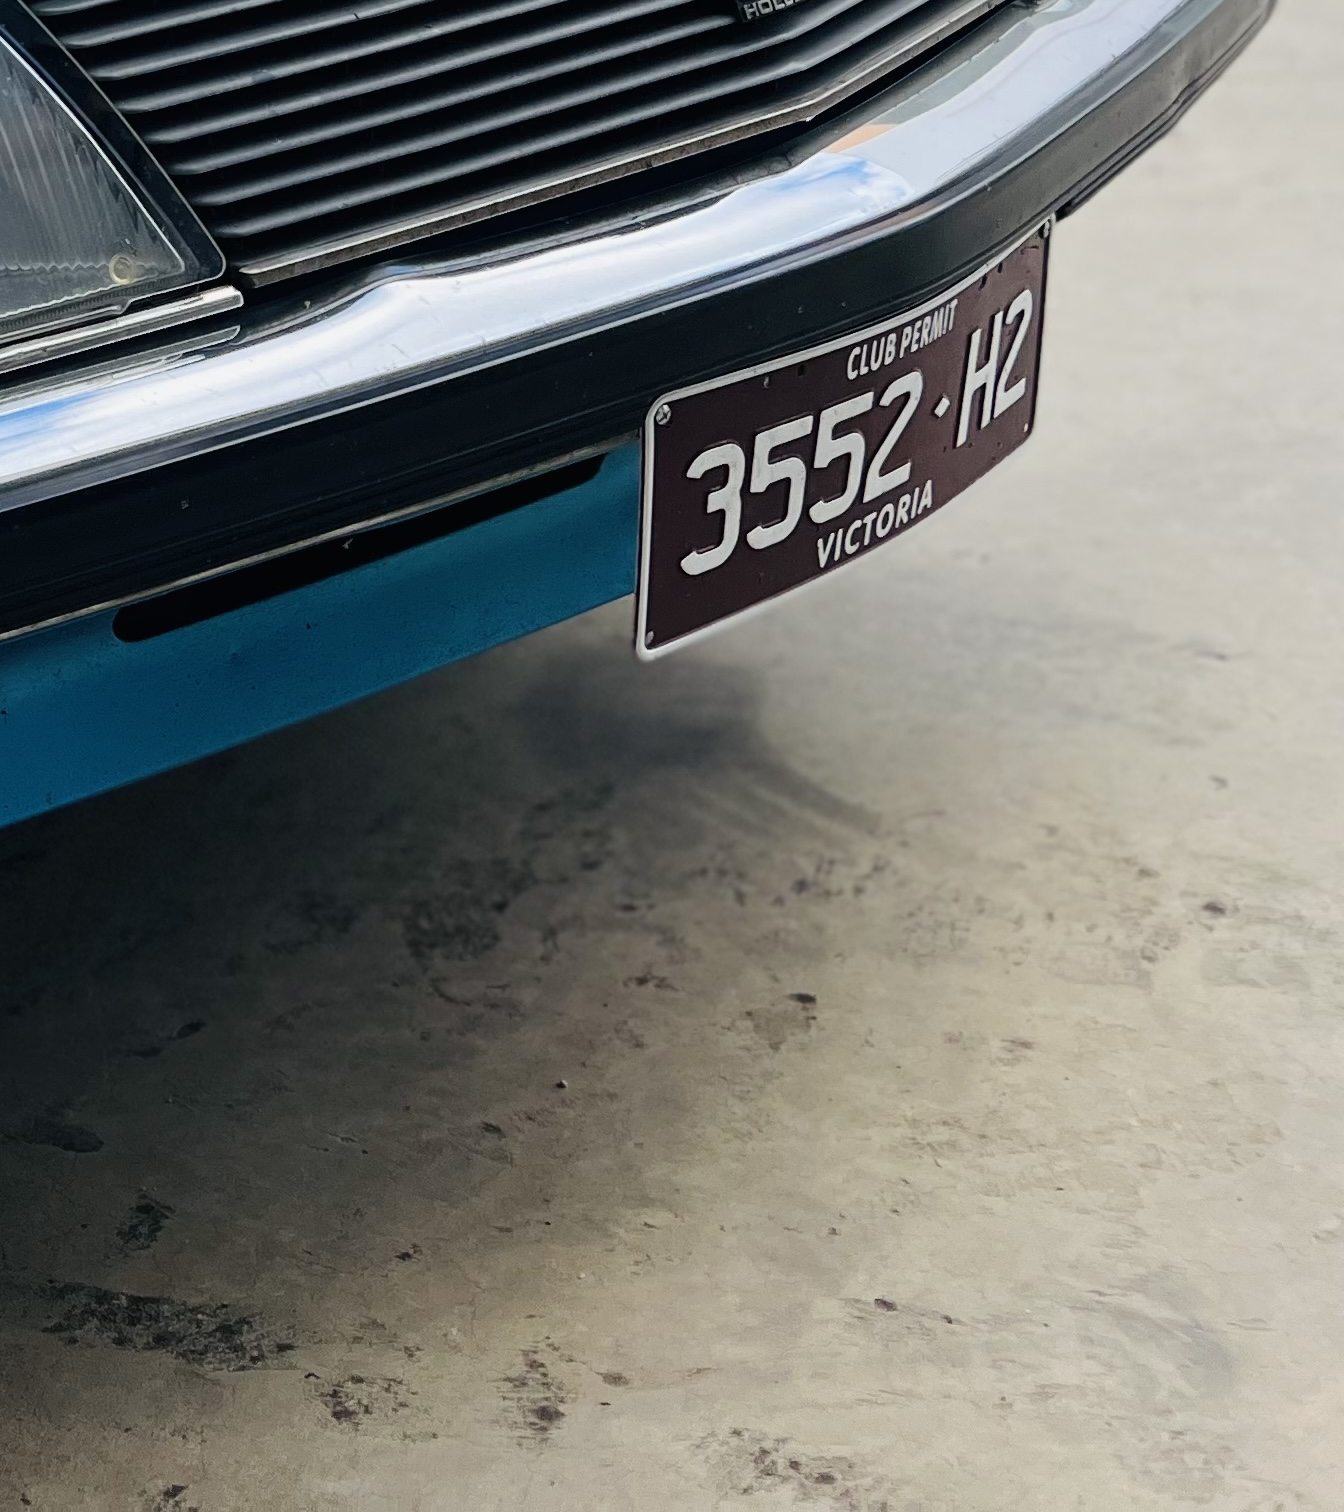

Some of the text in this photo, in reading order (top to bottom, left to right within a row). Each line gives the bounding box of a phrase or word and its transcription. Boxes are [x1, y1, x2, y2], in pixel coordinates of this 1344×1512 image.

[847, 299, 958, 380] CLUB PERMIT
[817, 479, 933, 568] VICTORIA
